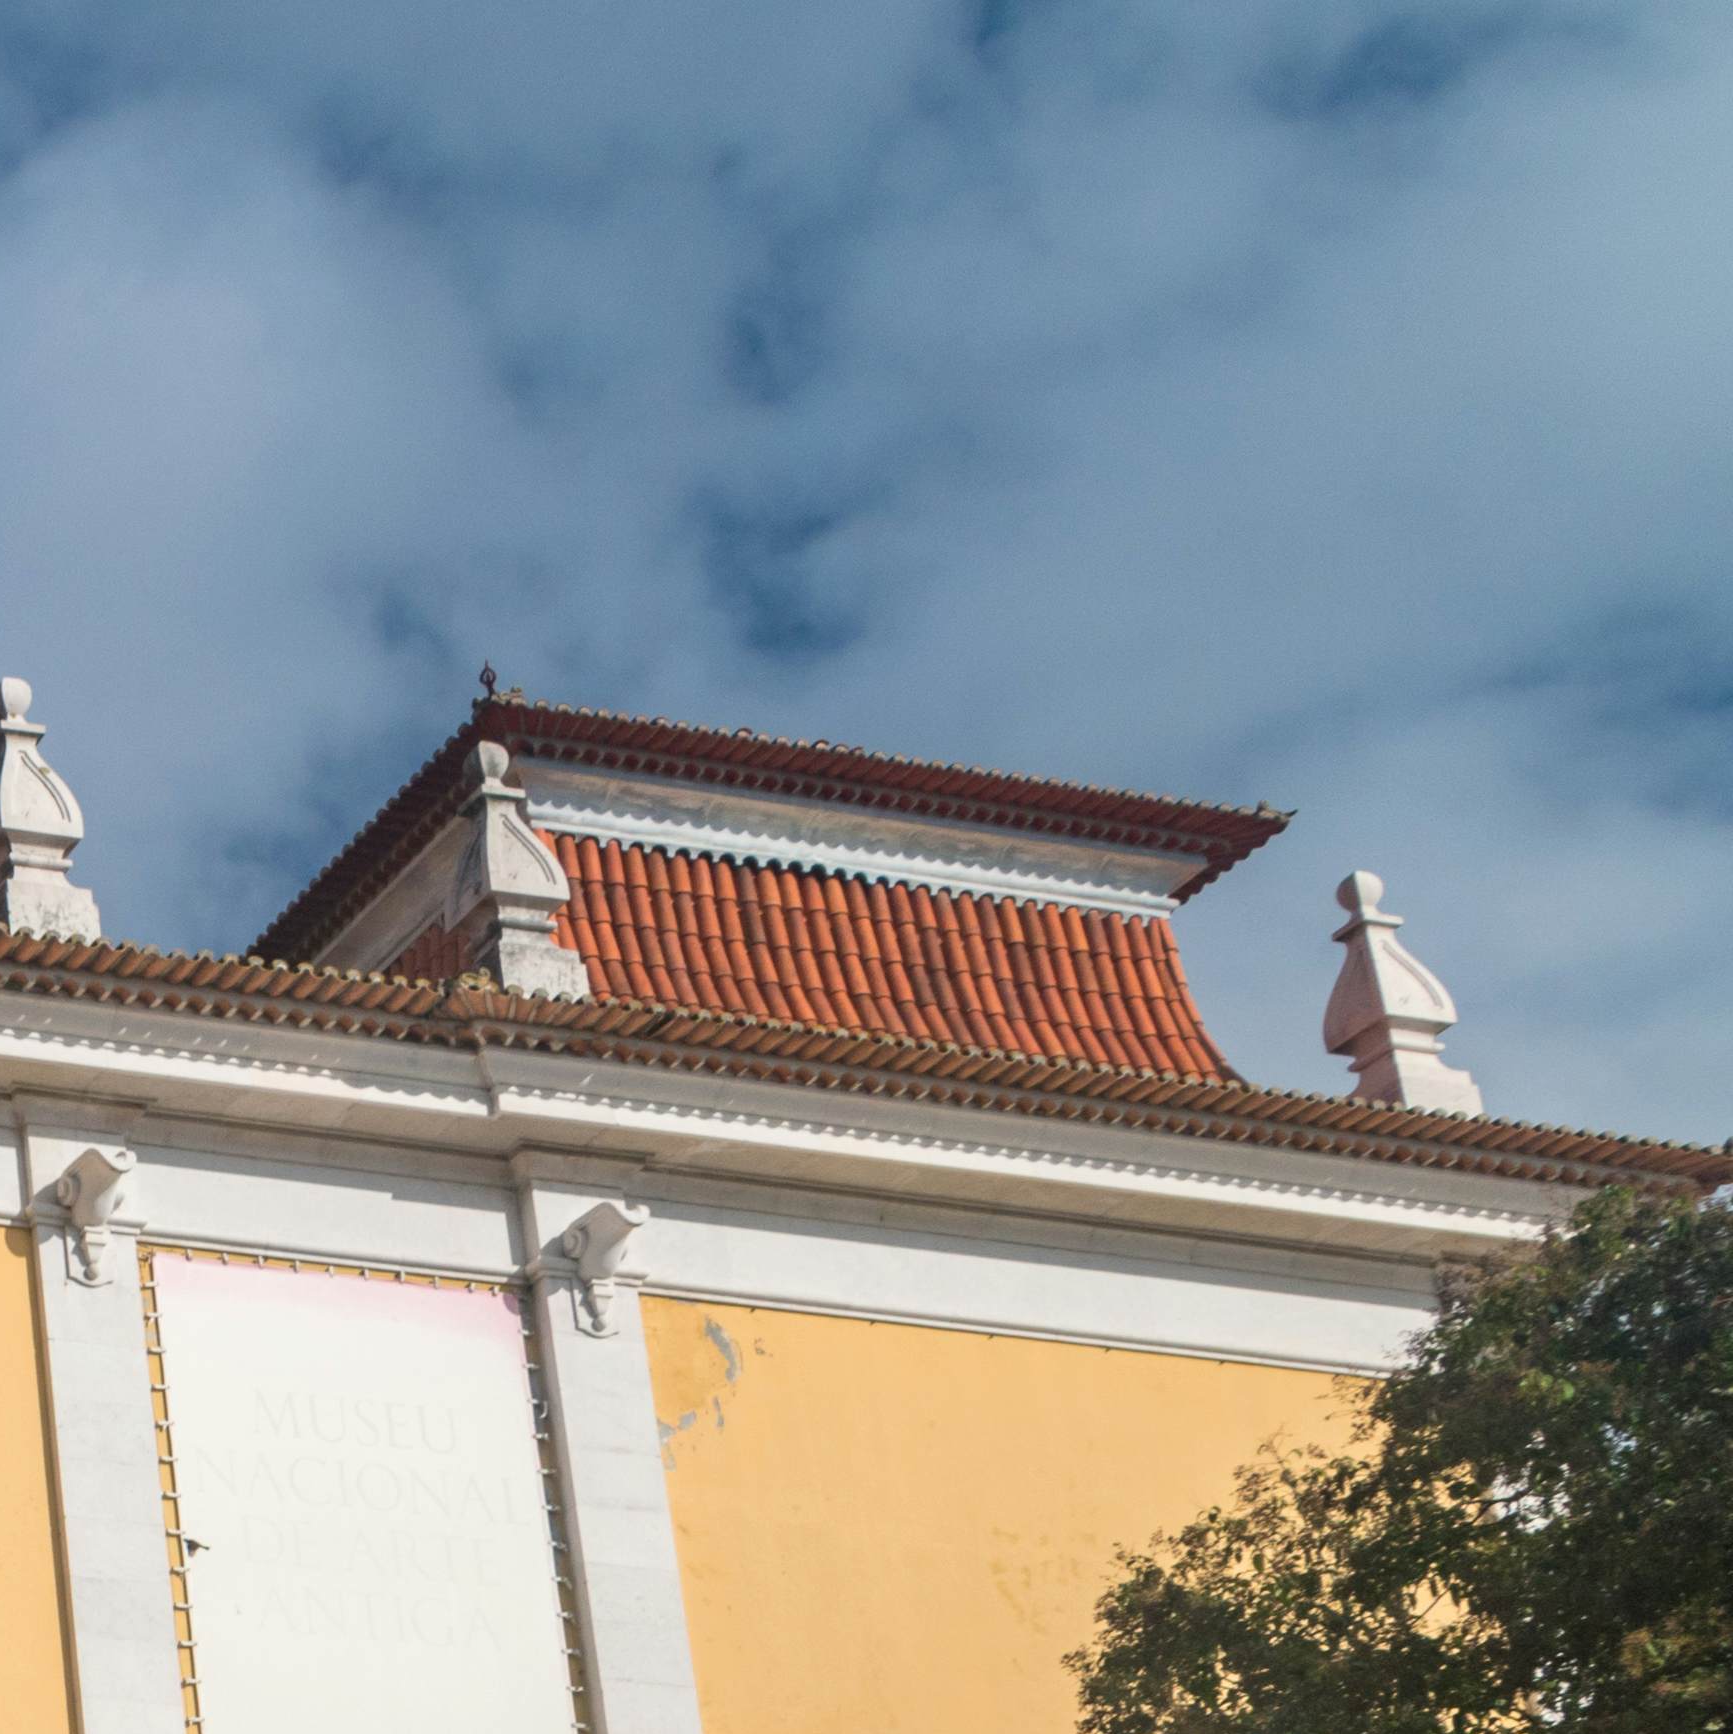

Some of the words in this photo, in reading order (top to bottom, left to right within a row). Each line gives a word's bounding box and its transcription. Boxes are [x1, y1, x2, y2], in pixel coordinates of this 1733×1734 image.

[252, 1388, 458, 1456] MUSEU
[191, 1445, 532, 1527] NACIONAL
[240, 1515, 318, 1570] DE
[346, 1528, 503, 1587] ARTE
